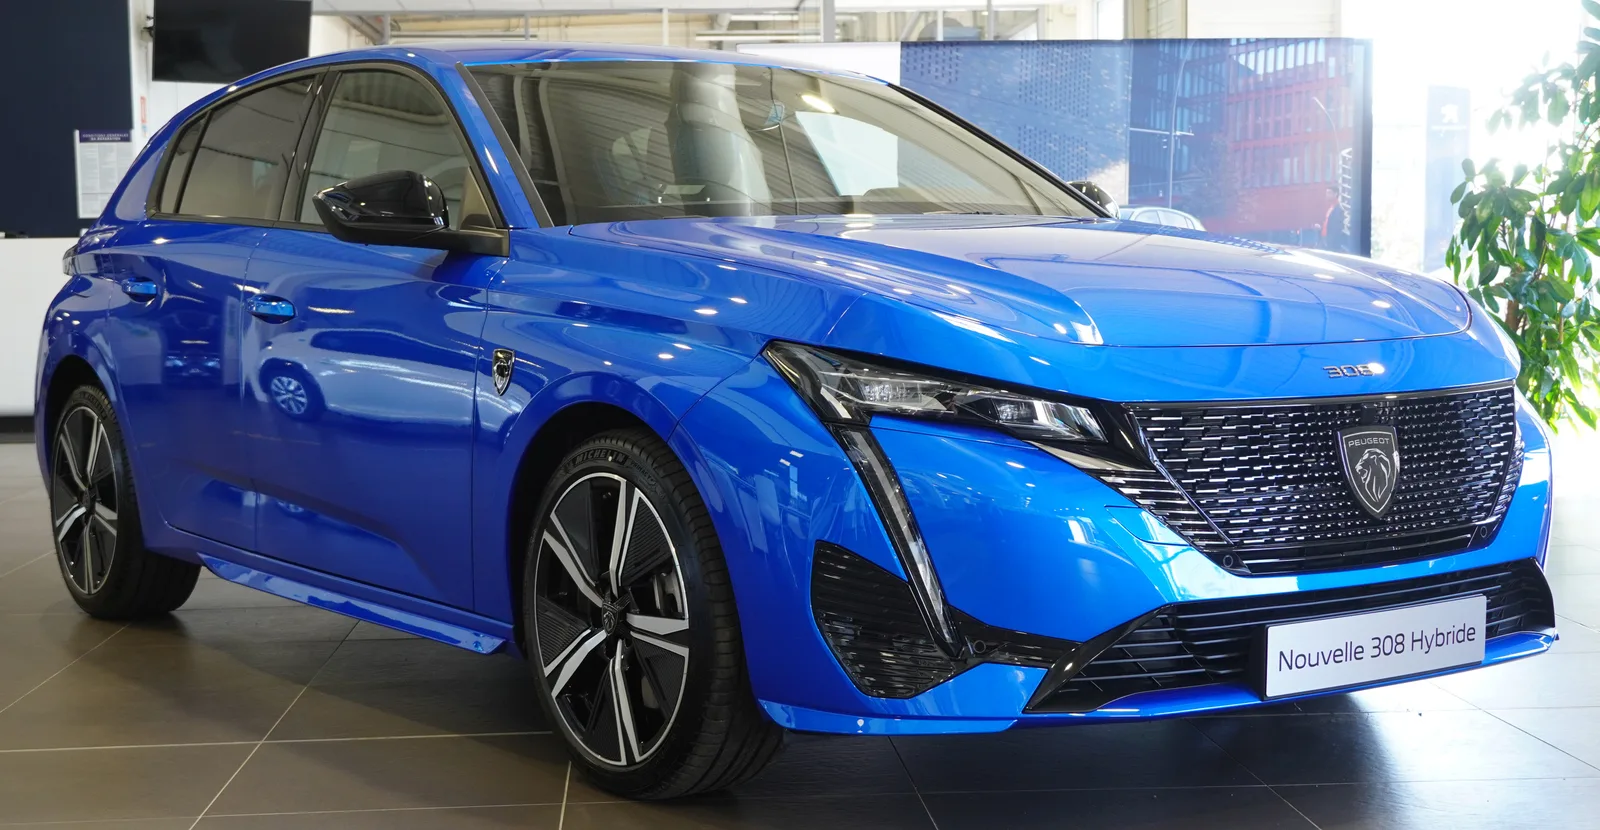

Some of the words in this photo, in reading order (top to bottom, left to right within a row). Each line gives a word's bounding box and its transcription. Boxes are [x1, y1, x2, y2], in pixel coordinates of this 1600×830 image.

[1323, 364, 1375, 379] 308
[1348, 437, 1390, 447] PEUGEOT
[575, 449, 624, 465] MICHELIN
[1278, 641, 1364, 672] Nouvelle
[1370, 633, 1405, 659] 308
[1411, 623, 1476, 654] Hybride
